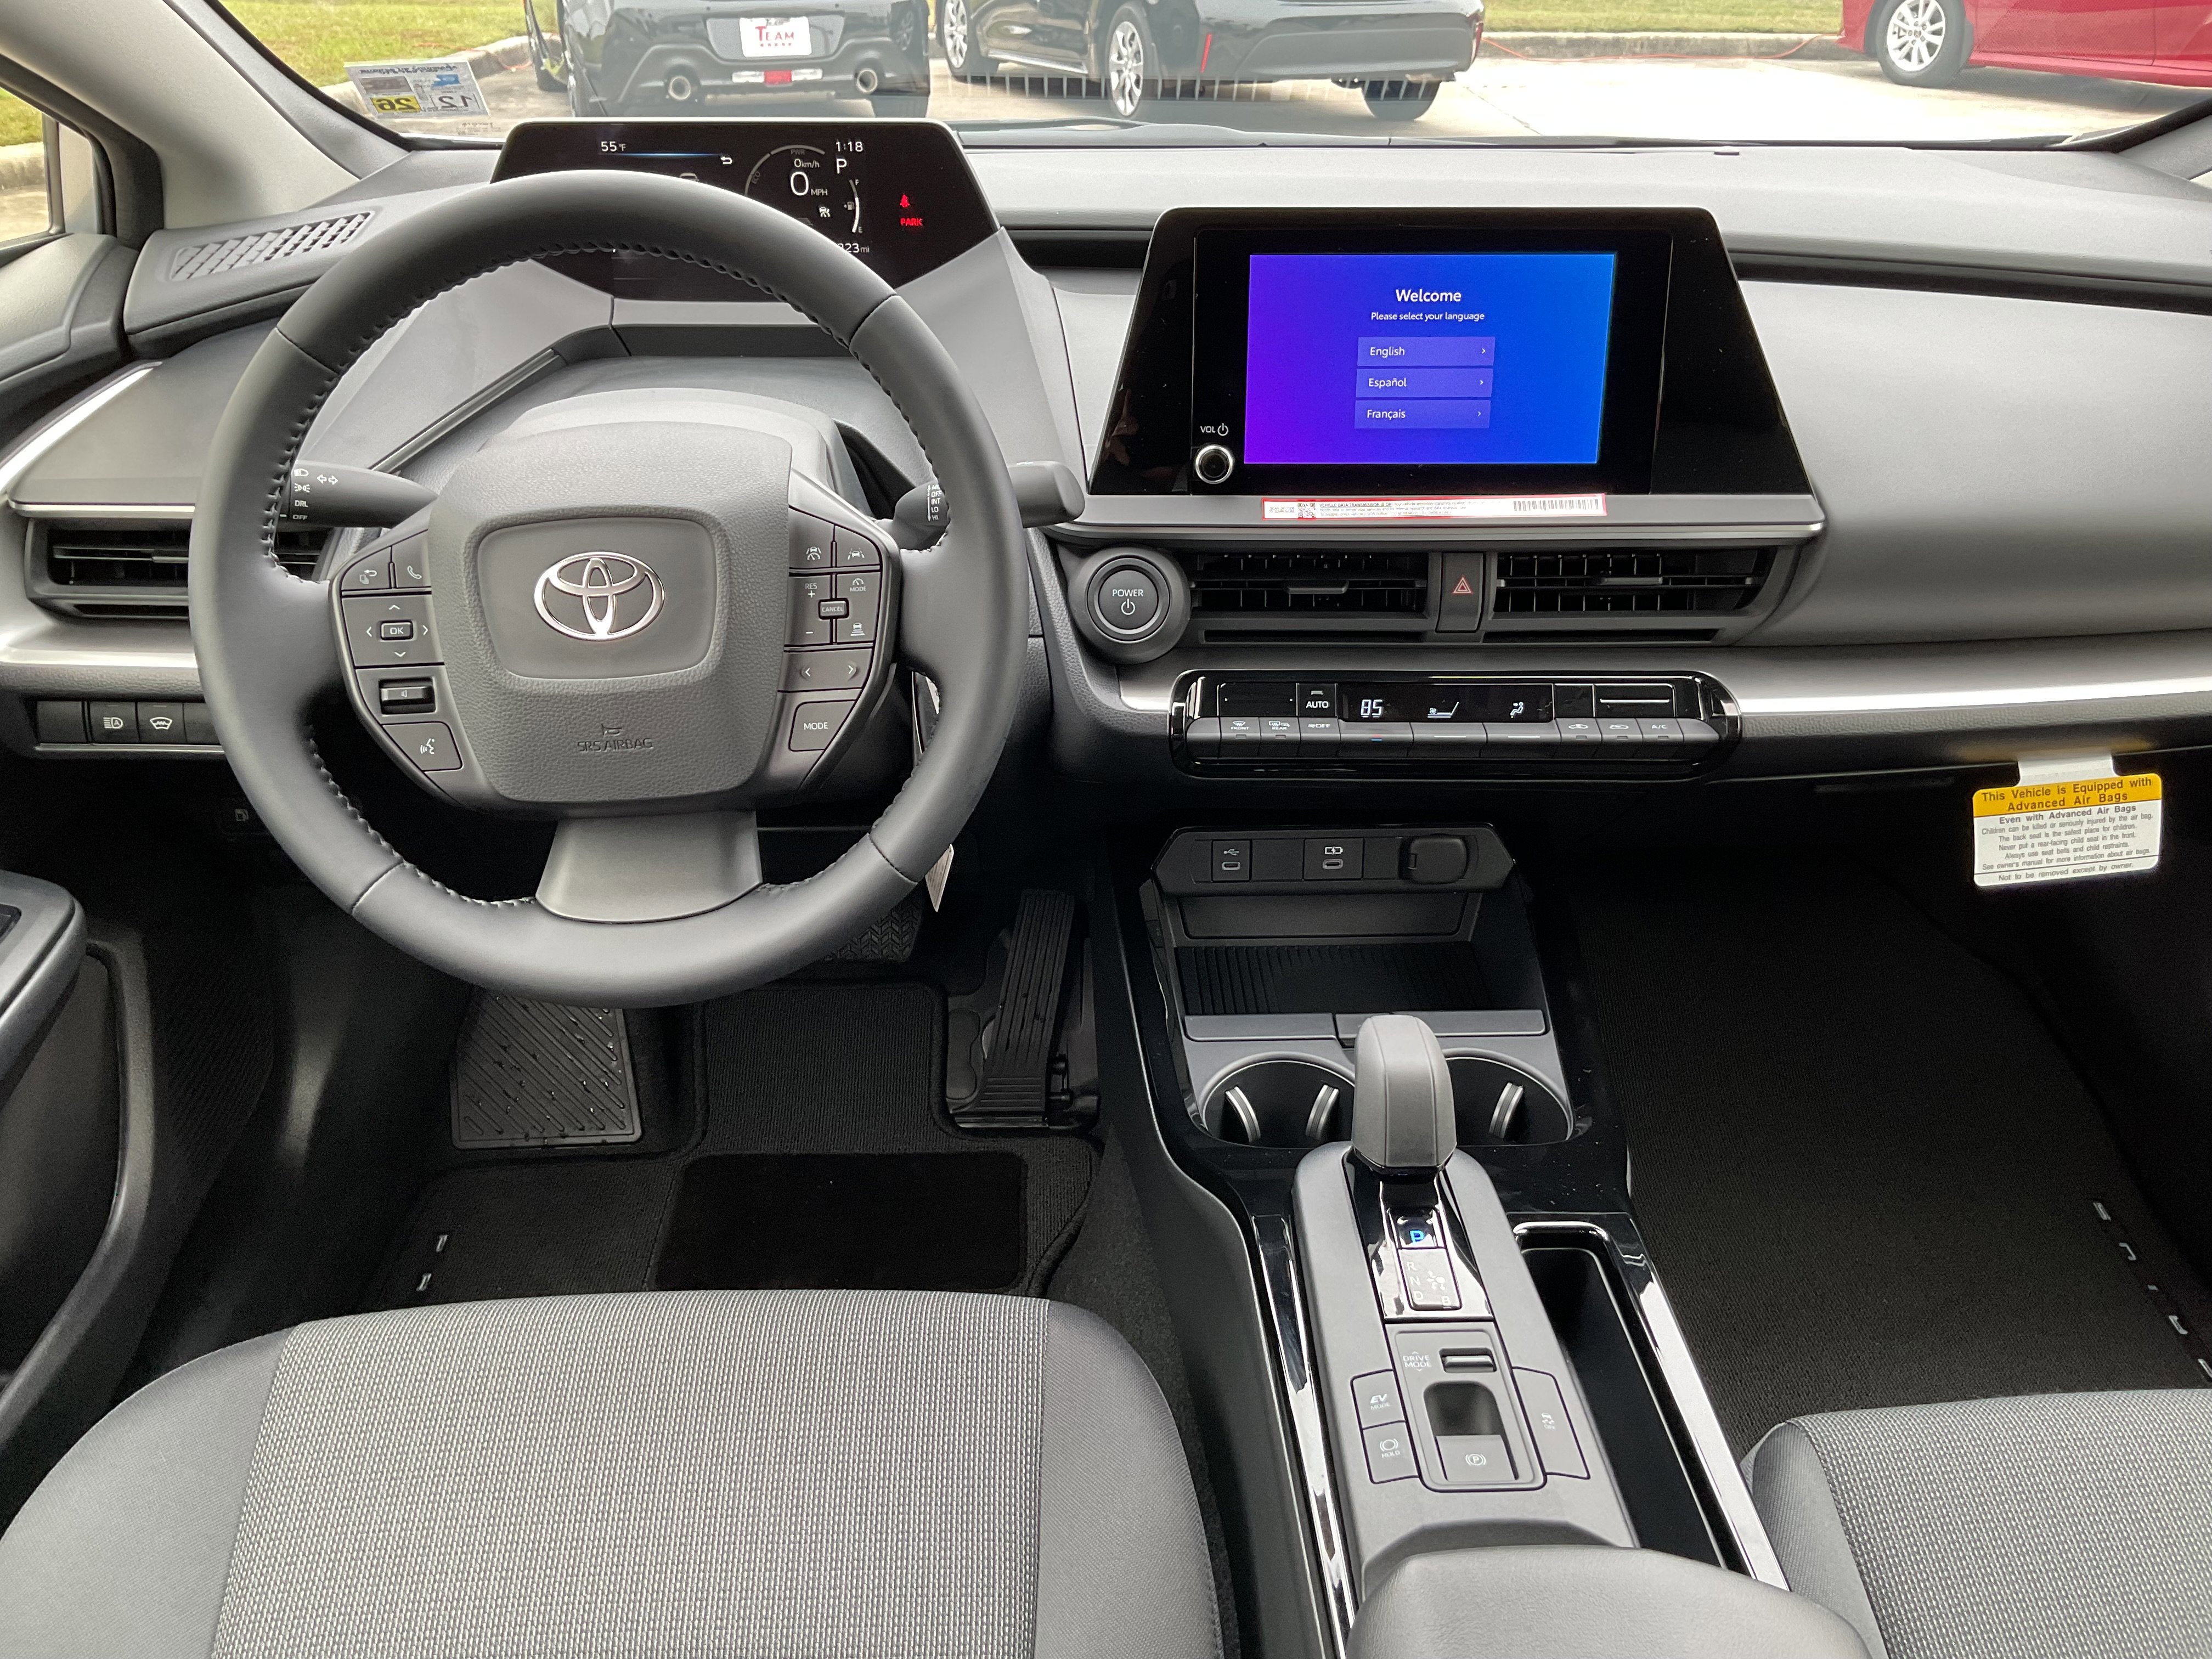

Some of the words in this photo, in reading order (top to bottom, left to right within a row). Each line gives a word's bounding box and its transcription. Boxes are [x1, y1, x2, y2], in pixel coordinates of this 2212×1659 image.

[835, 141, 864, 152] 1:18
[836, 158, 848, 174] P
[790, 171, 809, 196] 0
[900, 217, 924, 227] PARK
[1395, 289, 1462, 302] Welcome
[1371, 312, 1398, 320] Please
[1399, 312, 1423, 320] select
[1424, 313, 1443, 321] your
[1445, 312, 1485, 321] language
[1370, 347, 1405, 358] English
[1368, 377, 1407, 389] Español
[1367, 409, 1406, 420] Français
[1112, 589, 1143, 597] POWER
[390, 627, 404, 635] OK
[803, 721, 828, 730] MODE
[577, 741, 601, 753] SRS
[603, 738, 654, 752] AIRBAG
[1981, 791, 2006, 802] This
[2012, 787, 2051, 799] Vehicle
[2057, 786, 2066, 794] is
[2073, 780, 2123, 794] Equipped
[2129, 777, 2152, 787] with
[2007, 797, 2065, 812] Advanced
[2074, 795, 2090, 805] Air
[2099, 792, 2128, 803] Bags
[1999, 816, 2021, 824] Even
[2025, 813, 2044, 821] with
[2049, 808, 2092, 819] Advanced
[2114, 805, 2136, 814] Bags
[2059, 819, 2084, 828] seriously
[2086, 817, 2106, 826] injured
[2038, 839, 2068, 848] rear-facing
[2005, 851, 2025, 860] Always
[2074, 853, 2104, 861] information
[2039, 868, 2069, 877] removed
[2072, 865, 2095, 874] except
[1410, 1230, 1425, 1245] P
[1406, 1262, 1417, 1271] R
[1409, 1276, 1421, 1285] N
[1413, 1290, 1424, 1300] D
[1441, 1295, 1452, 1306] B
[1370, 1393, 1387, 1403] EV
[1381, 1450, 1400, 1458] HOLD
